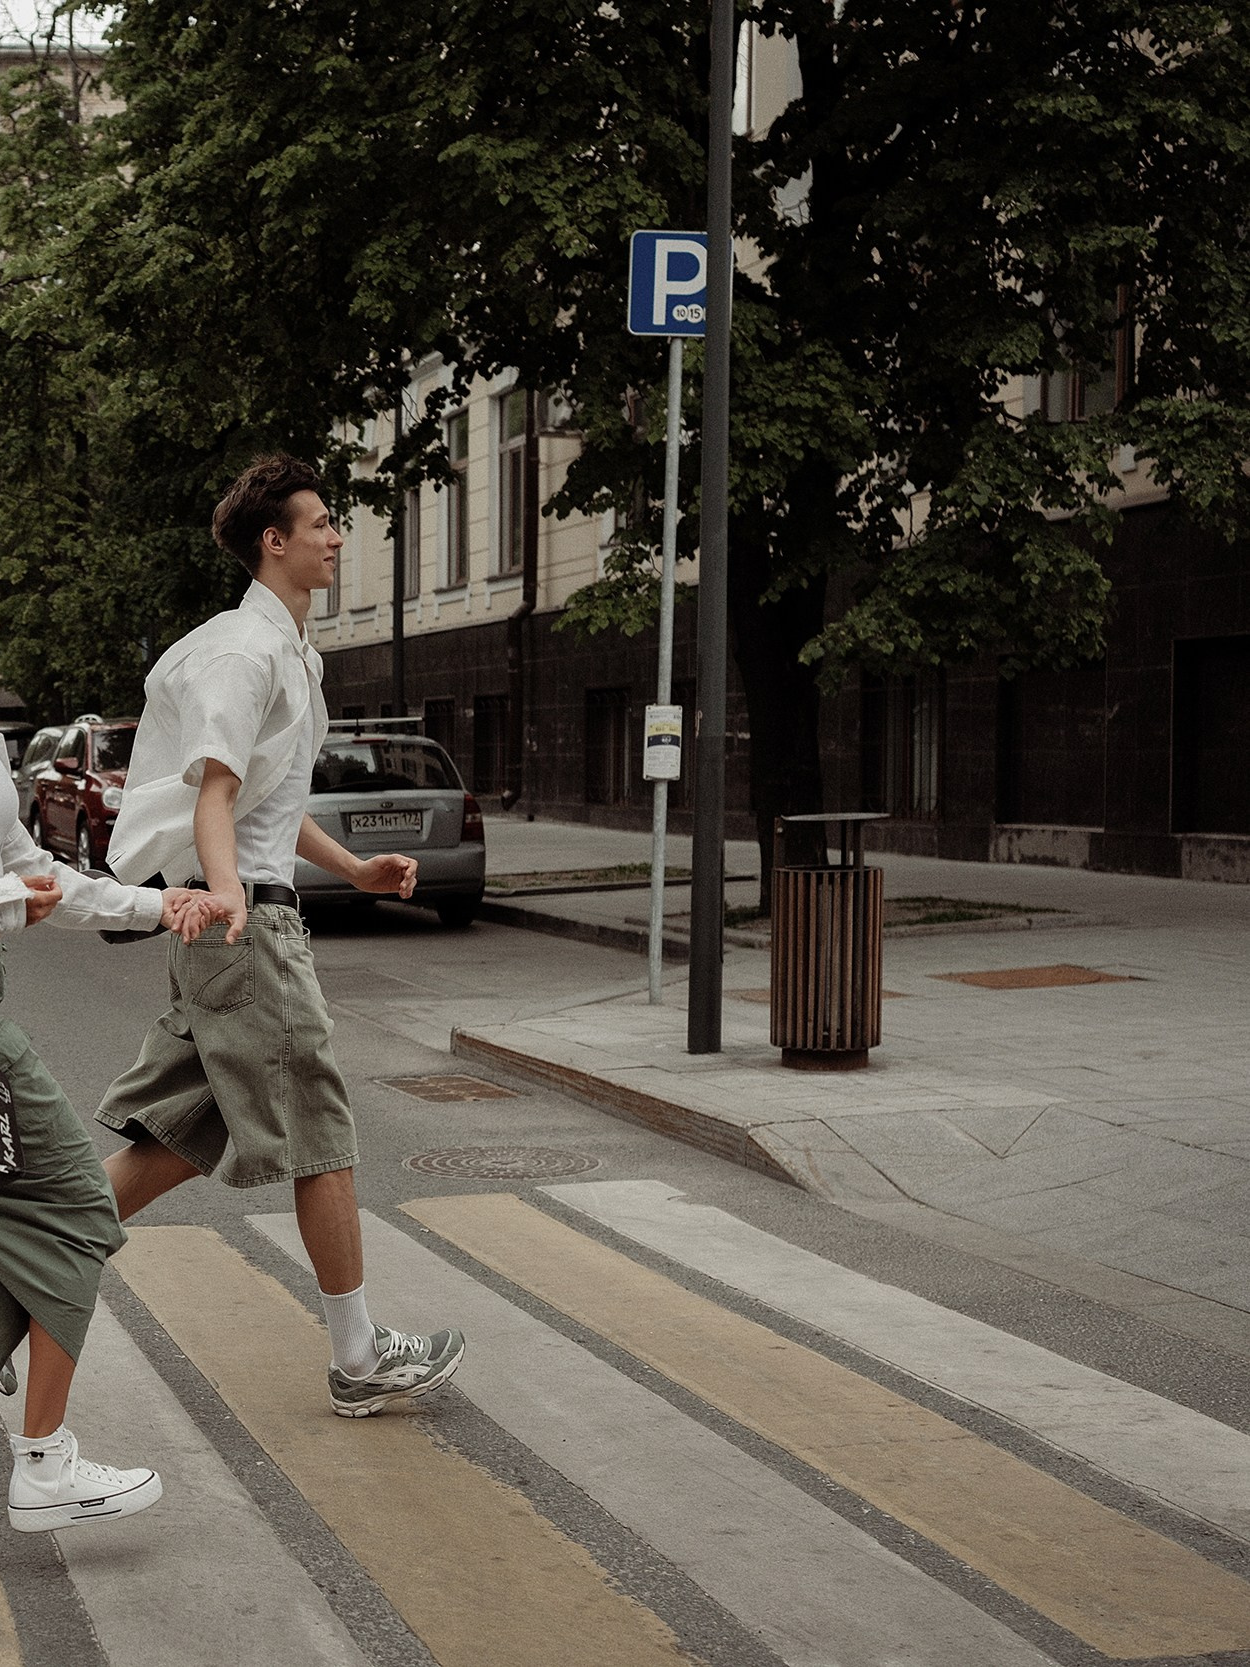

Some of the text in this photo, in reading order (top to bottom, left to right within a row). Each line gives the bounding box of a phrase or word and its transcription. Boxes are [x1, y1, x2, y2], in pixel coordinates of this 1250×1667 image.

[653, 239, 708, 325] P
[676, 309, 686, 318] 10
[690, 308, 701, 319] 15
